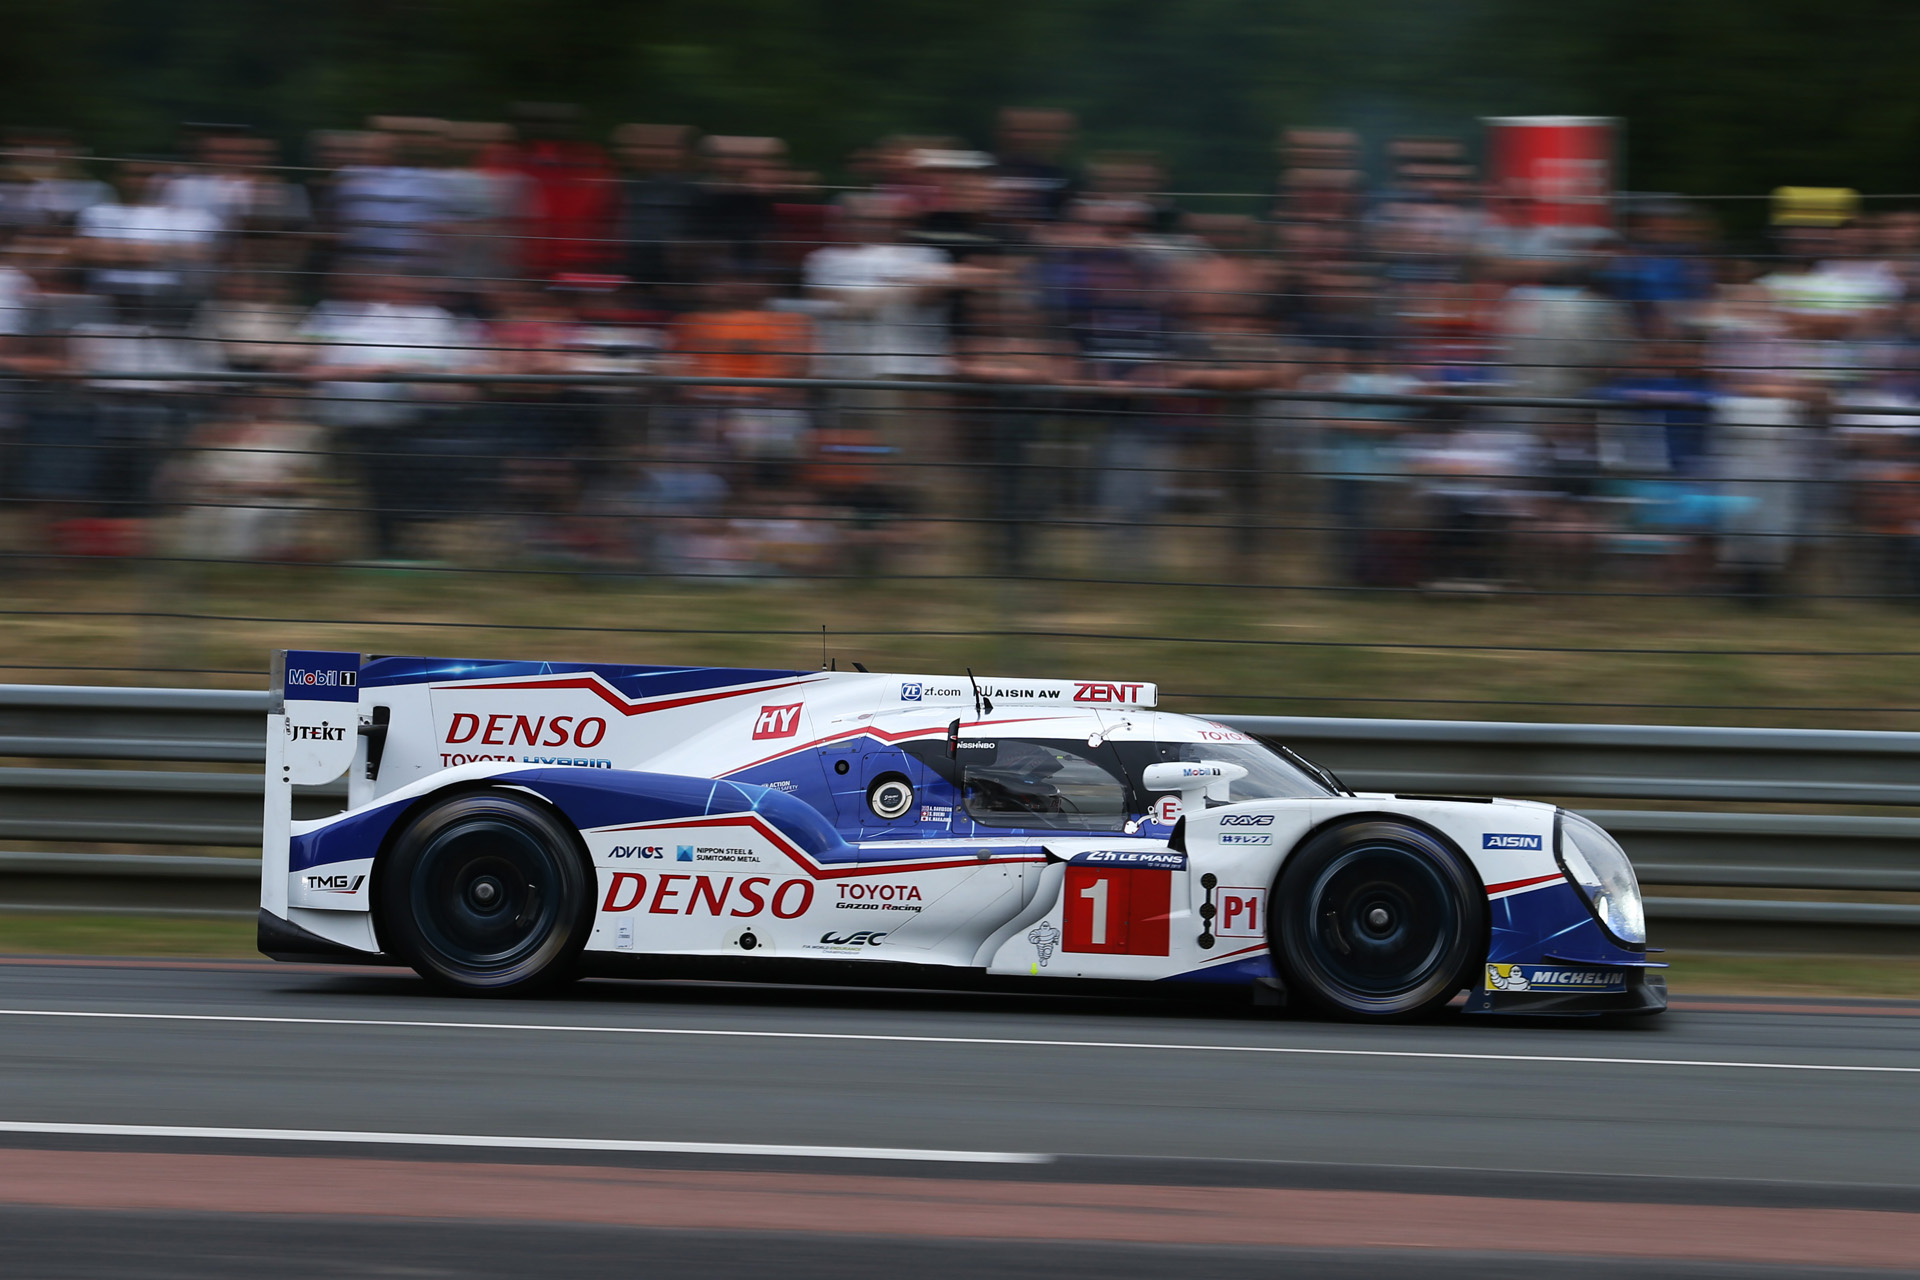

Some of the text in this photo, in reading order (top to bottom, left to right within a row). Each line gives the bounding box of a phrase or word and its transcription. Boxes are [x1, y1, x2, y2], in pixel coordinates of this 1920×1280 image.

[289, 669, 338, 686] Mobil
[924, 686, 961, 697] zf.com
[995, 689, 1061, 699] AISIN AW
[1073, 683, 1144, 703] ZENT
[755, 706, 800, 734] HY
[292, 725, 346, 742] JTEKT
[445, 713, 607, 748] DENSO
[1183, 768, 1211, 777] Mobil
[769, 780, 791, 788] ACTION
[1220, 815, 1275, 826] RAYS
[1487, 836, 1539, 848] AISIN
[608, 845, 664, 859] ADVICS
[696, 847, 725, 855] NIPPON
[696, 854, 736, 862] SUMITOMO
[1119, 853, 1139, 862] LE
[1140, 855, 1183, 864] MANS
[307, 876, 348, 889] TMG
[601, 872, 815, 919] DENSO
[836, 883, 922, 901] TOYOTA
[881, 904, 922, 913] Racing
[1081, 878, 1109, 945] 1
[1223, 896, 1257, 930] P1
[820, 931, 888, 946] WEC
[1530, 971, 1624, 985] MICHELIN
